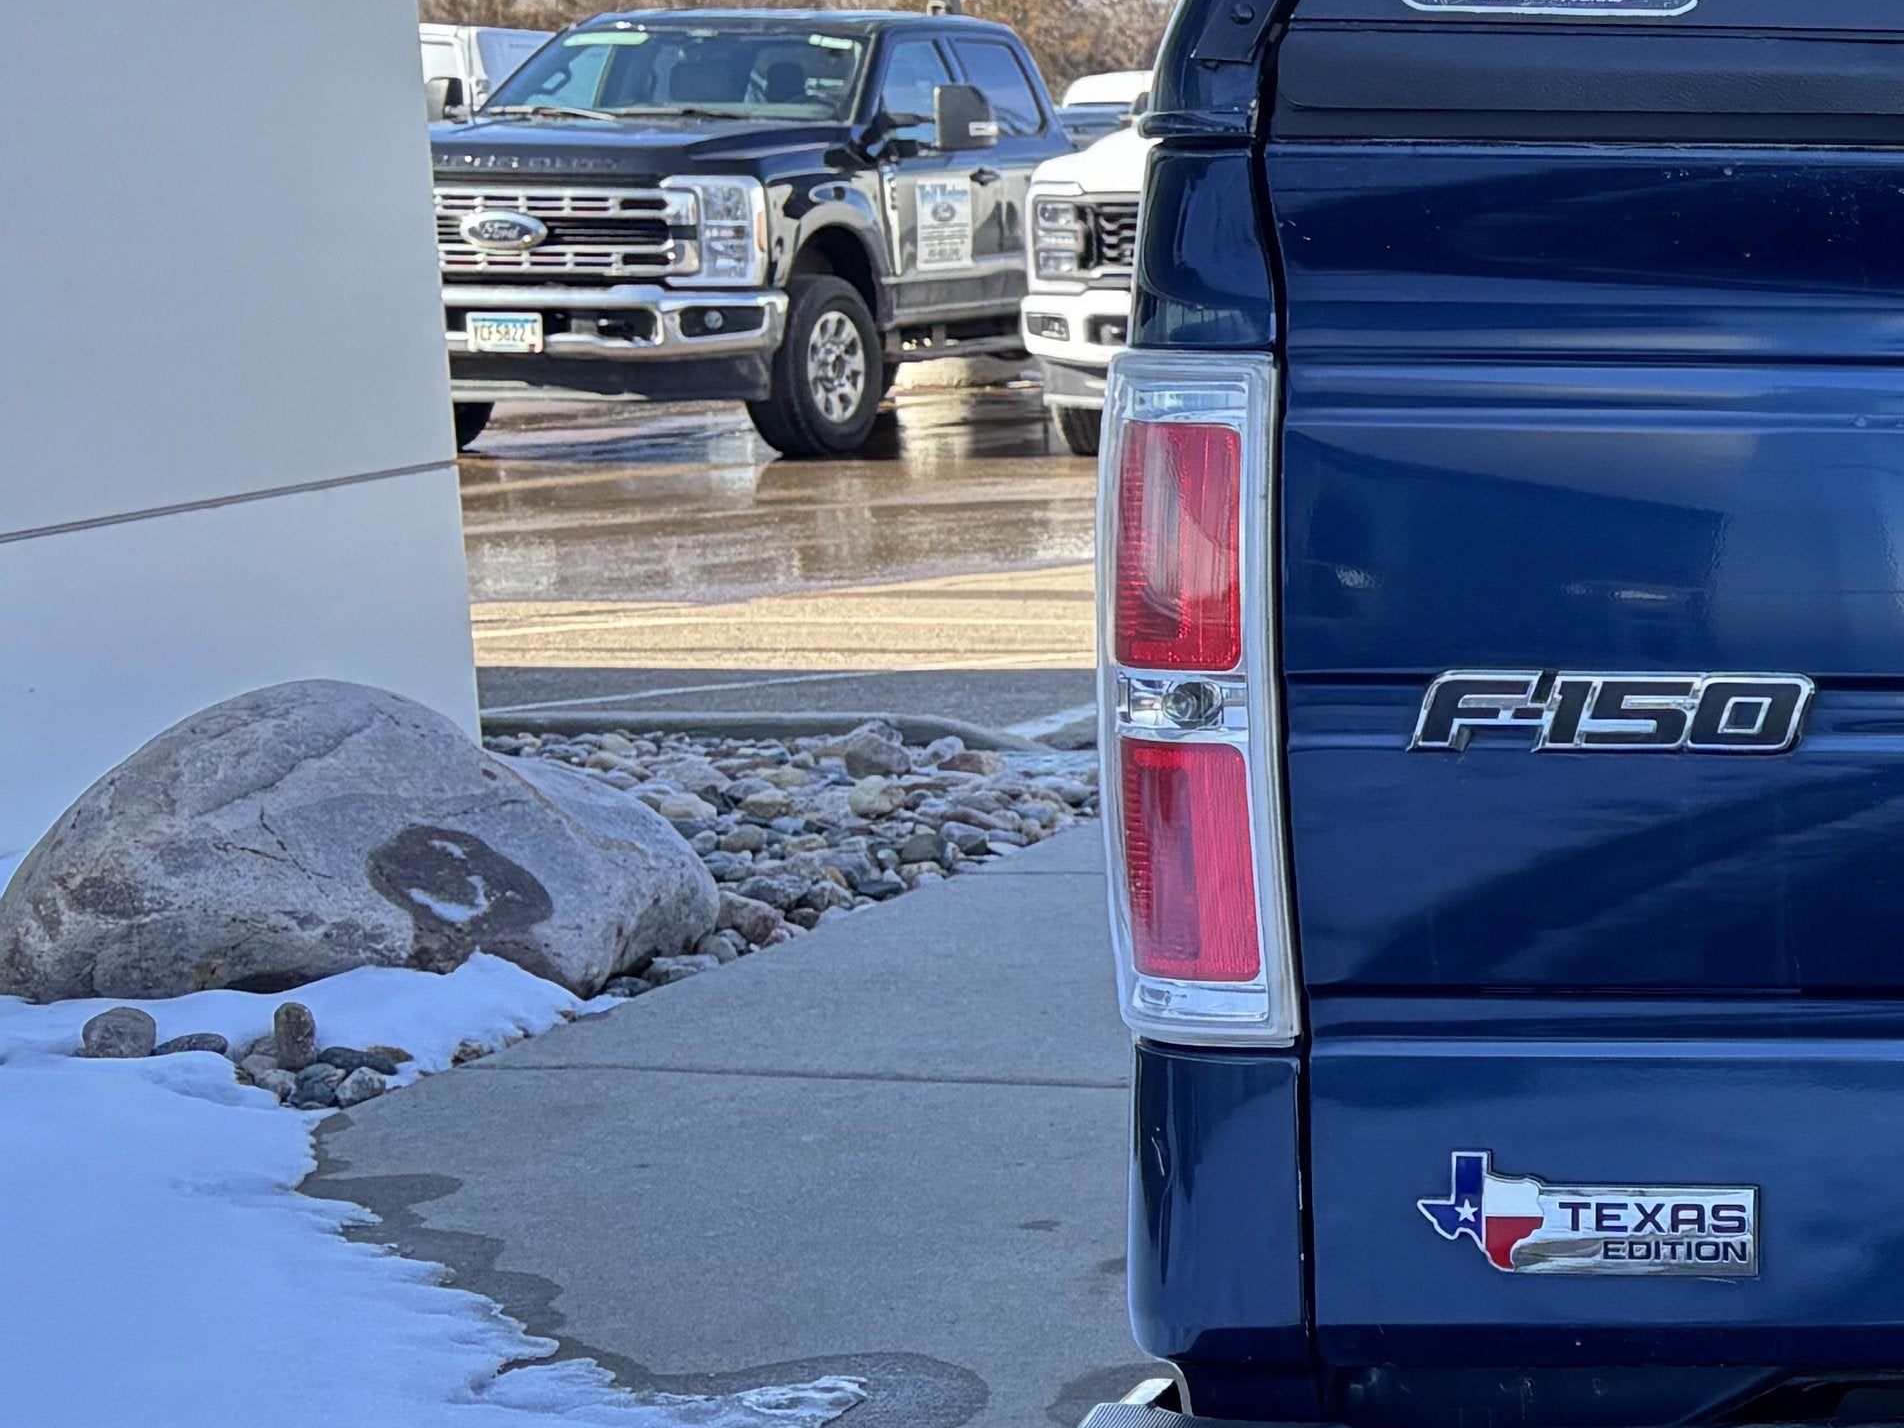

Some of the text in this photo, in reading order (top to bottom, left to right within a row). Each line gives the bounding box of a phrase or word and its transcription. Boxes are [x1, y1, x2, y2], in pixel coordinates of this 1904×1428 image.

[1406, 668, 1817, 755] F-150
[1557, 1201, 1747, 1234] TEXAS
[1602, 1240, 1748, 1263] EDITION
